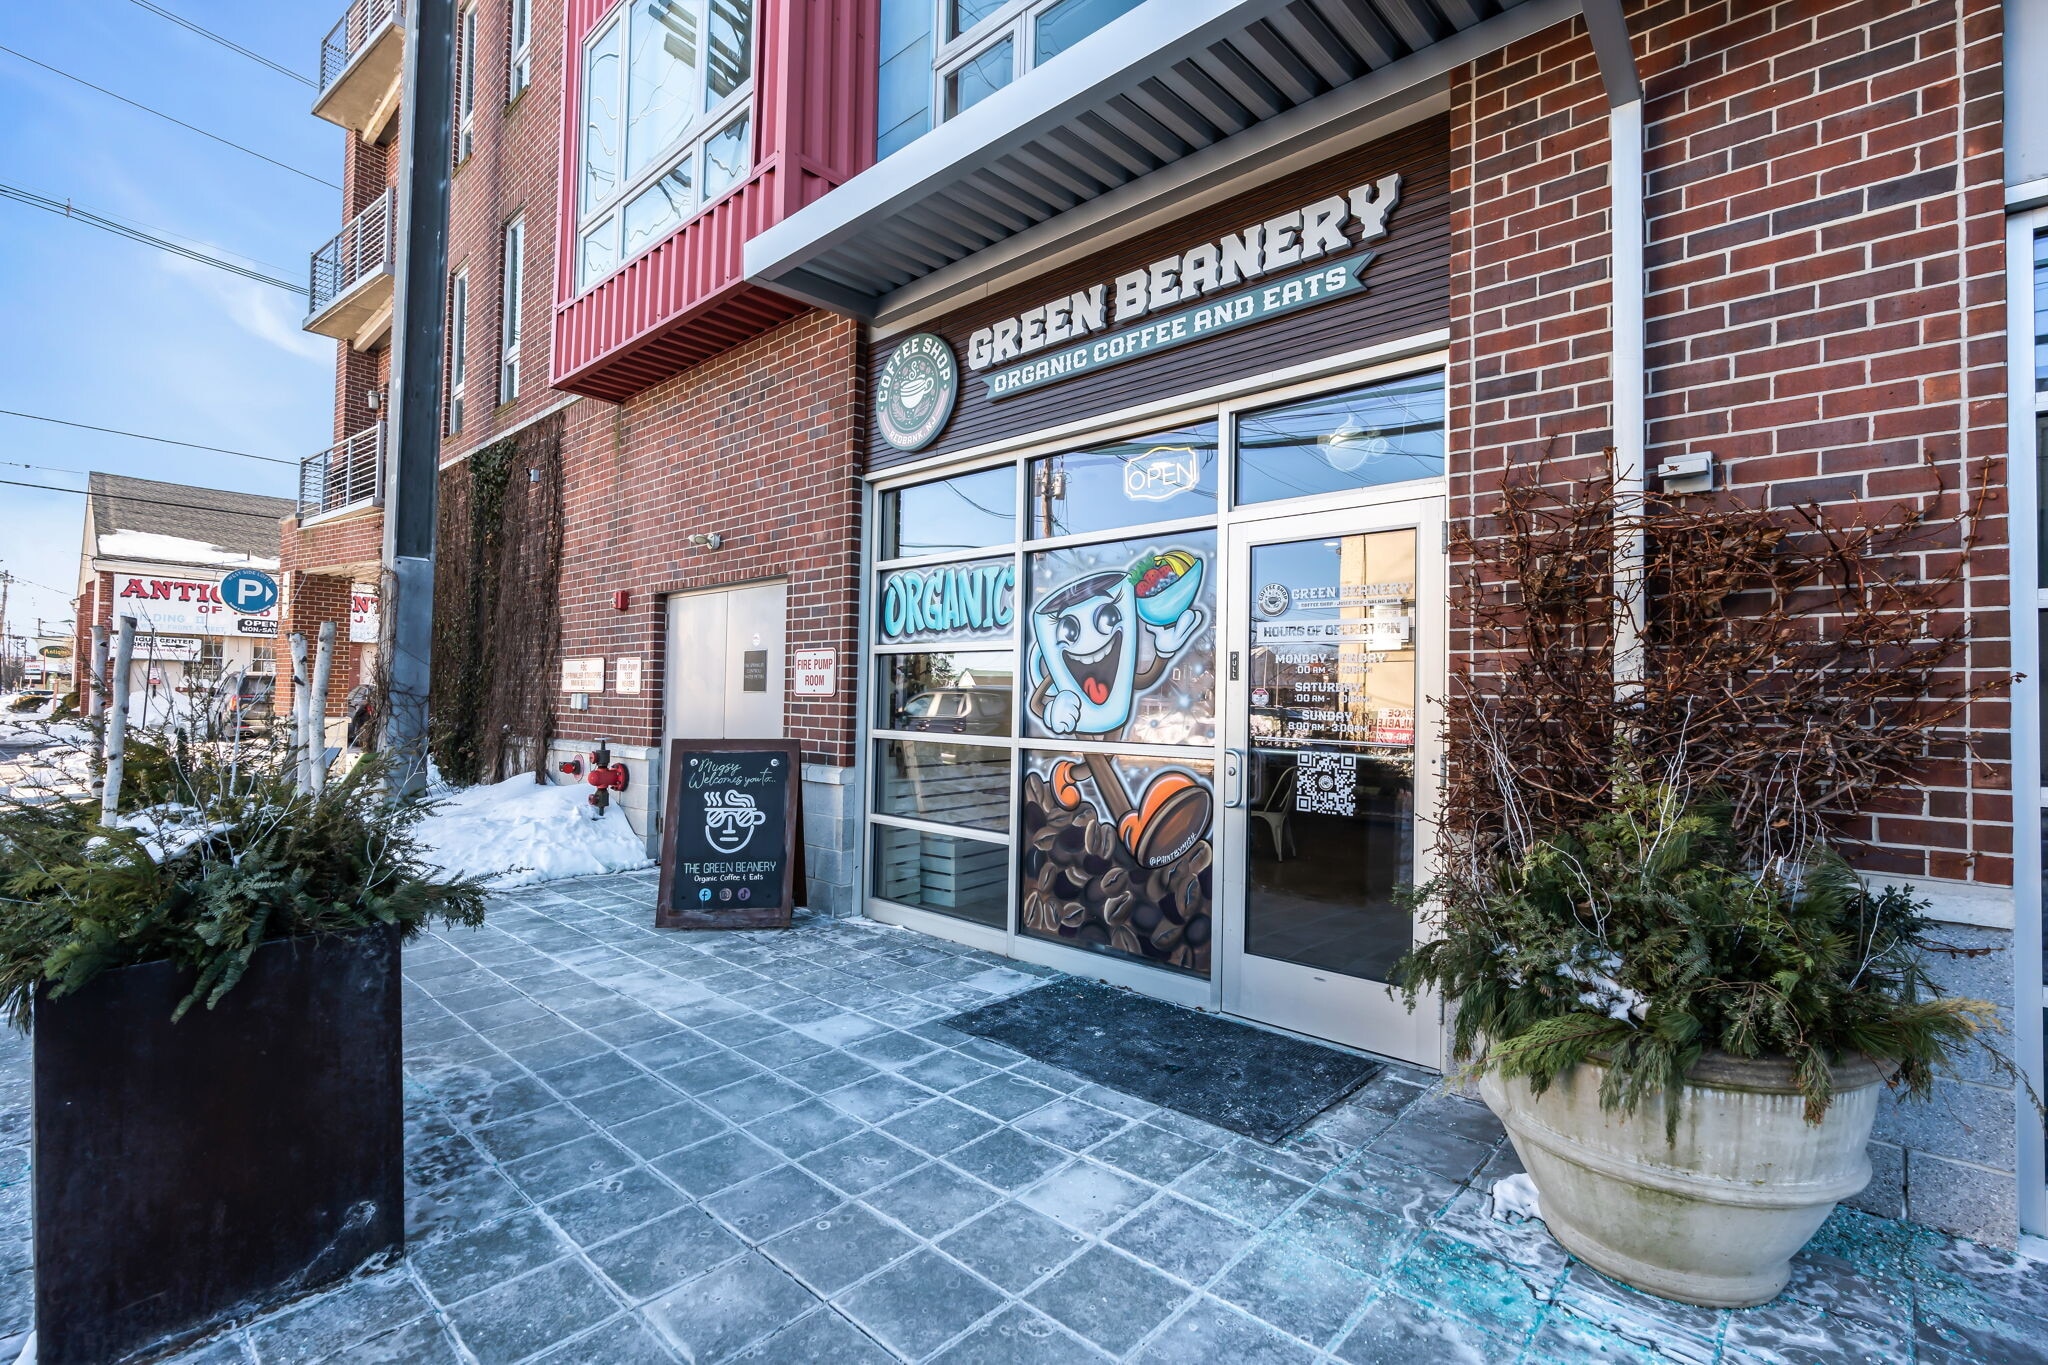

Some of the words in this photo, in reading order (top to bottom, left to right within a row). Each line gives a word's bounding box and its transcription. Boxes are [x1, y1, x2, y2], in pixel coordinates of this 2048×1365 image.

[967, 284, 1108, 372] GREEN
[1114, 172, 1402, 324] BEANERY
[993, 349, 1088, 394] ORGANIC
[1093, 318, 1187, 362] COFFEE
[1193, 296, 1257, 334] AND
[1262, 266, 1348, 310] EATS
[878, 337, 920, 403] COFFEE
[922, 337, 951, 381] SHOP
[1128, 460, 1194, 491] OPEN
[257, 571, 273, 585] LOFTS
[237, 578, 263, 605] P
[1277, 585, 1288, 600] SHOP
[1291, 586, 1336, 600] GREEN
[883, 564, 1015, 638] ORGANIC
[198, 605, 223, 614] OF
[244, 620, 277, 628] OPEN
[1263, 624, 1306, 638] HOURS
[1307, 624, 1323, 637] OF
[797, 659, 812, 671] FIRE
[813, 658, 833, 671] PUMP
[1275, 652, 1327, 664] MONDAY
[804, 674, 825, 687] ROOM
[1294, 682, 1362, 693] SATURDAY
[1301, 710, 1354, 722] SUNDAY
[1288, 721, 1310, 731] 8:00
[1311, 723, 1325, 731] AM
[698, 758, 742, 777] Mugsy
[688, 771, 742, 789] Welcomes
[743, 776, 761, 788] you
[683, 862, 700, 874] THE
[703, 861, 734, 874] GREEN
[735, 861, 777, 873] BEANERY
[694, 874, 718, 883] Organic
[720, 873, 740, 882] Coffee
[749, 873, 764, 881] Eats
